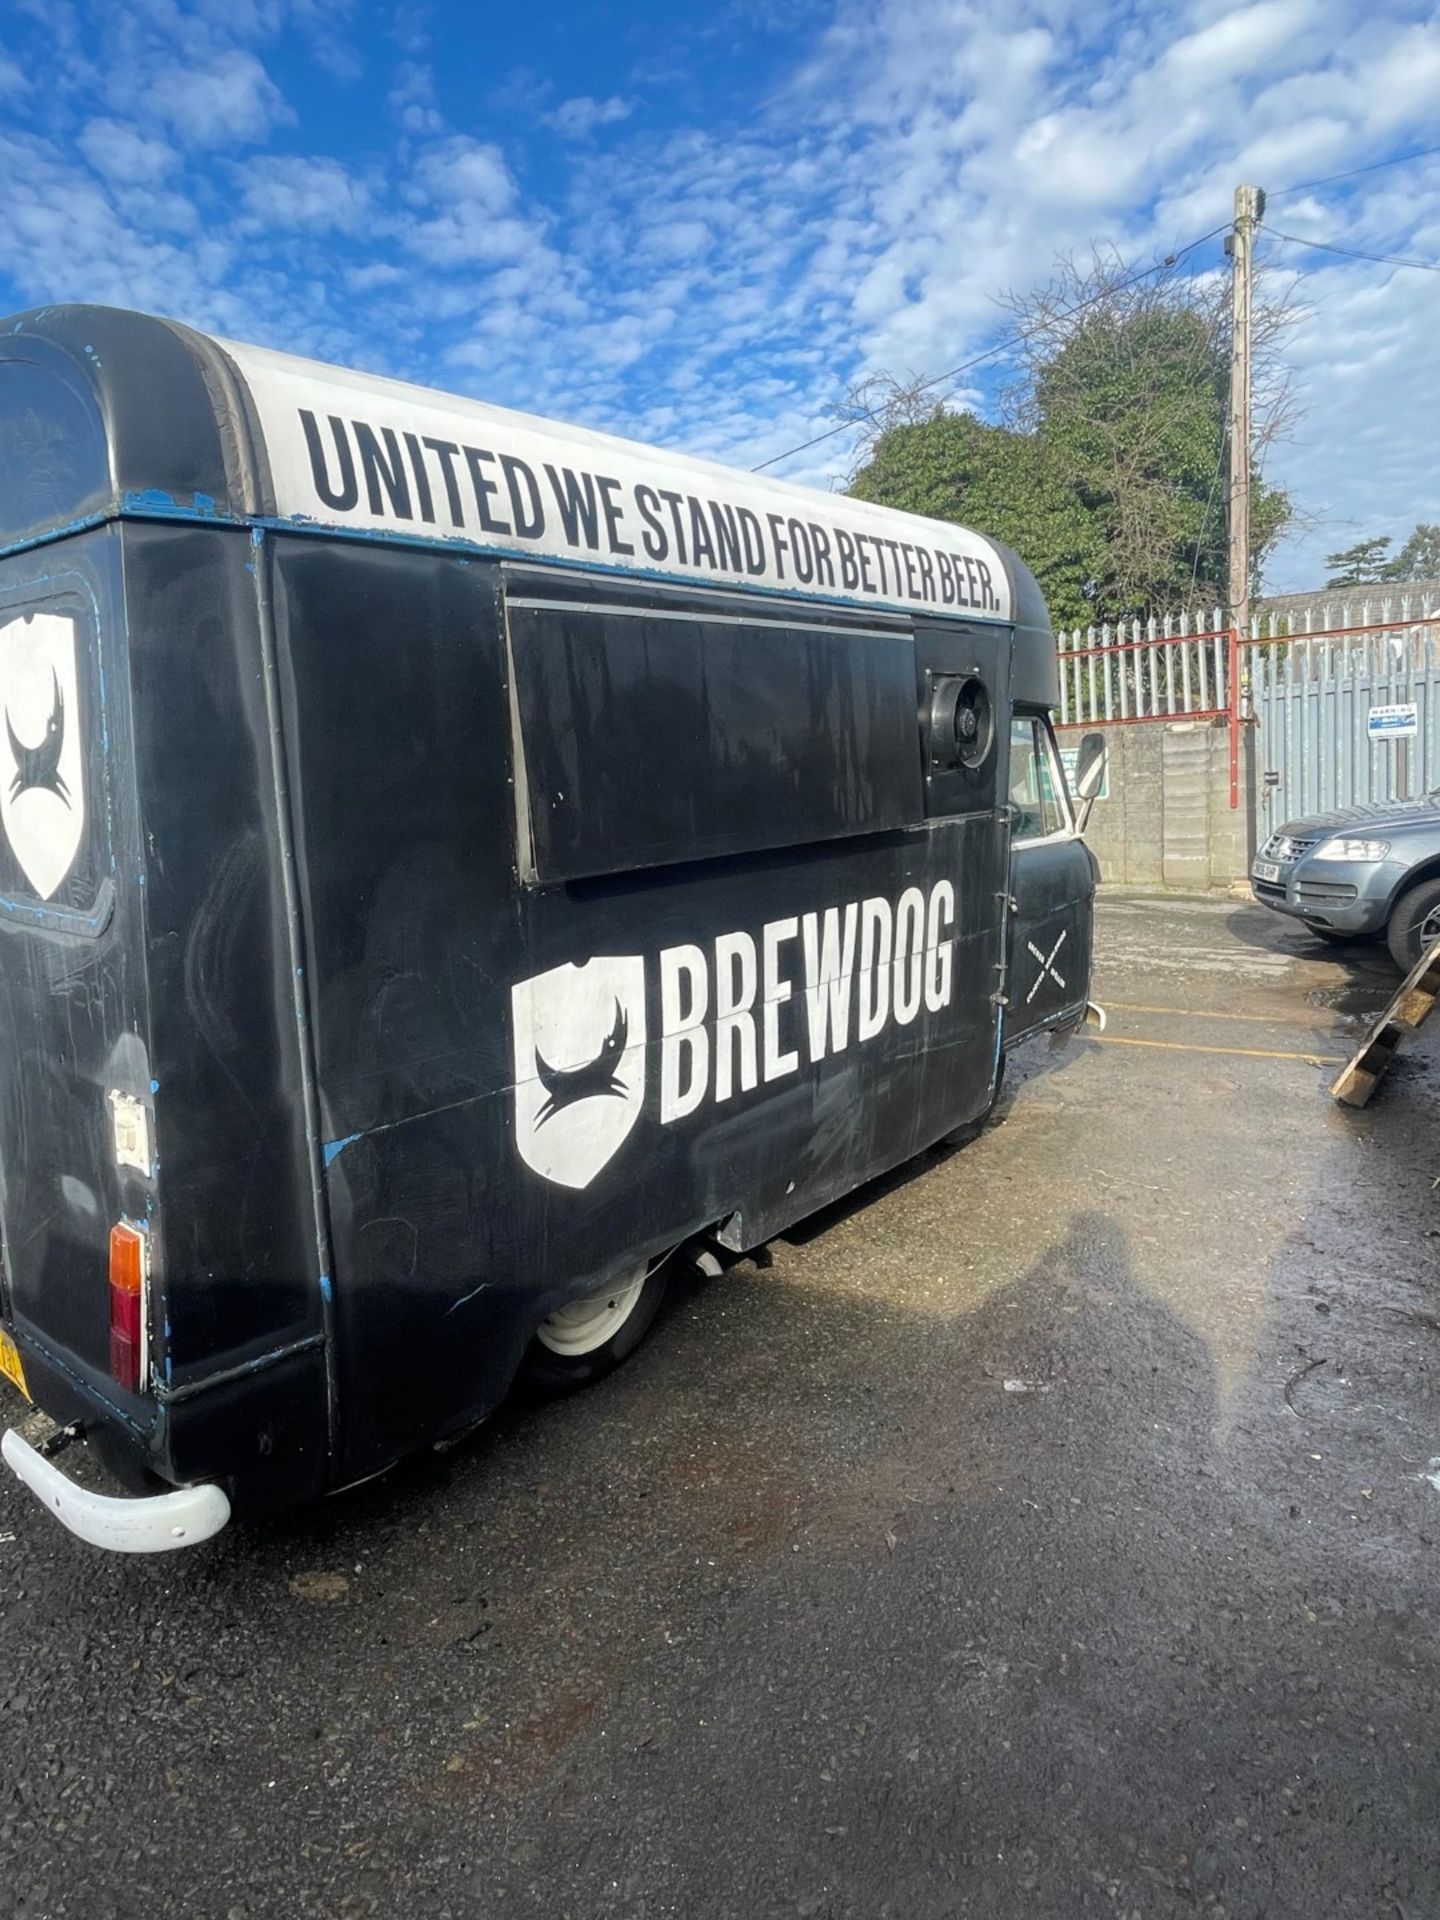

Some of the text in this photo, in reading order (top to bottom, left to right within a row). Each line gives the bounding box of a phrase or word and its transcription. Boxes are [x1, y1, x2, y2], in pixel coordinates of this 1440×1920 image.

[298, 408, 1000, 612] UNITED WE STAND FOR BETTER BEER.
[660, 879, 955, 1124] BREWDOG
